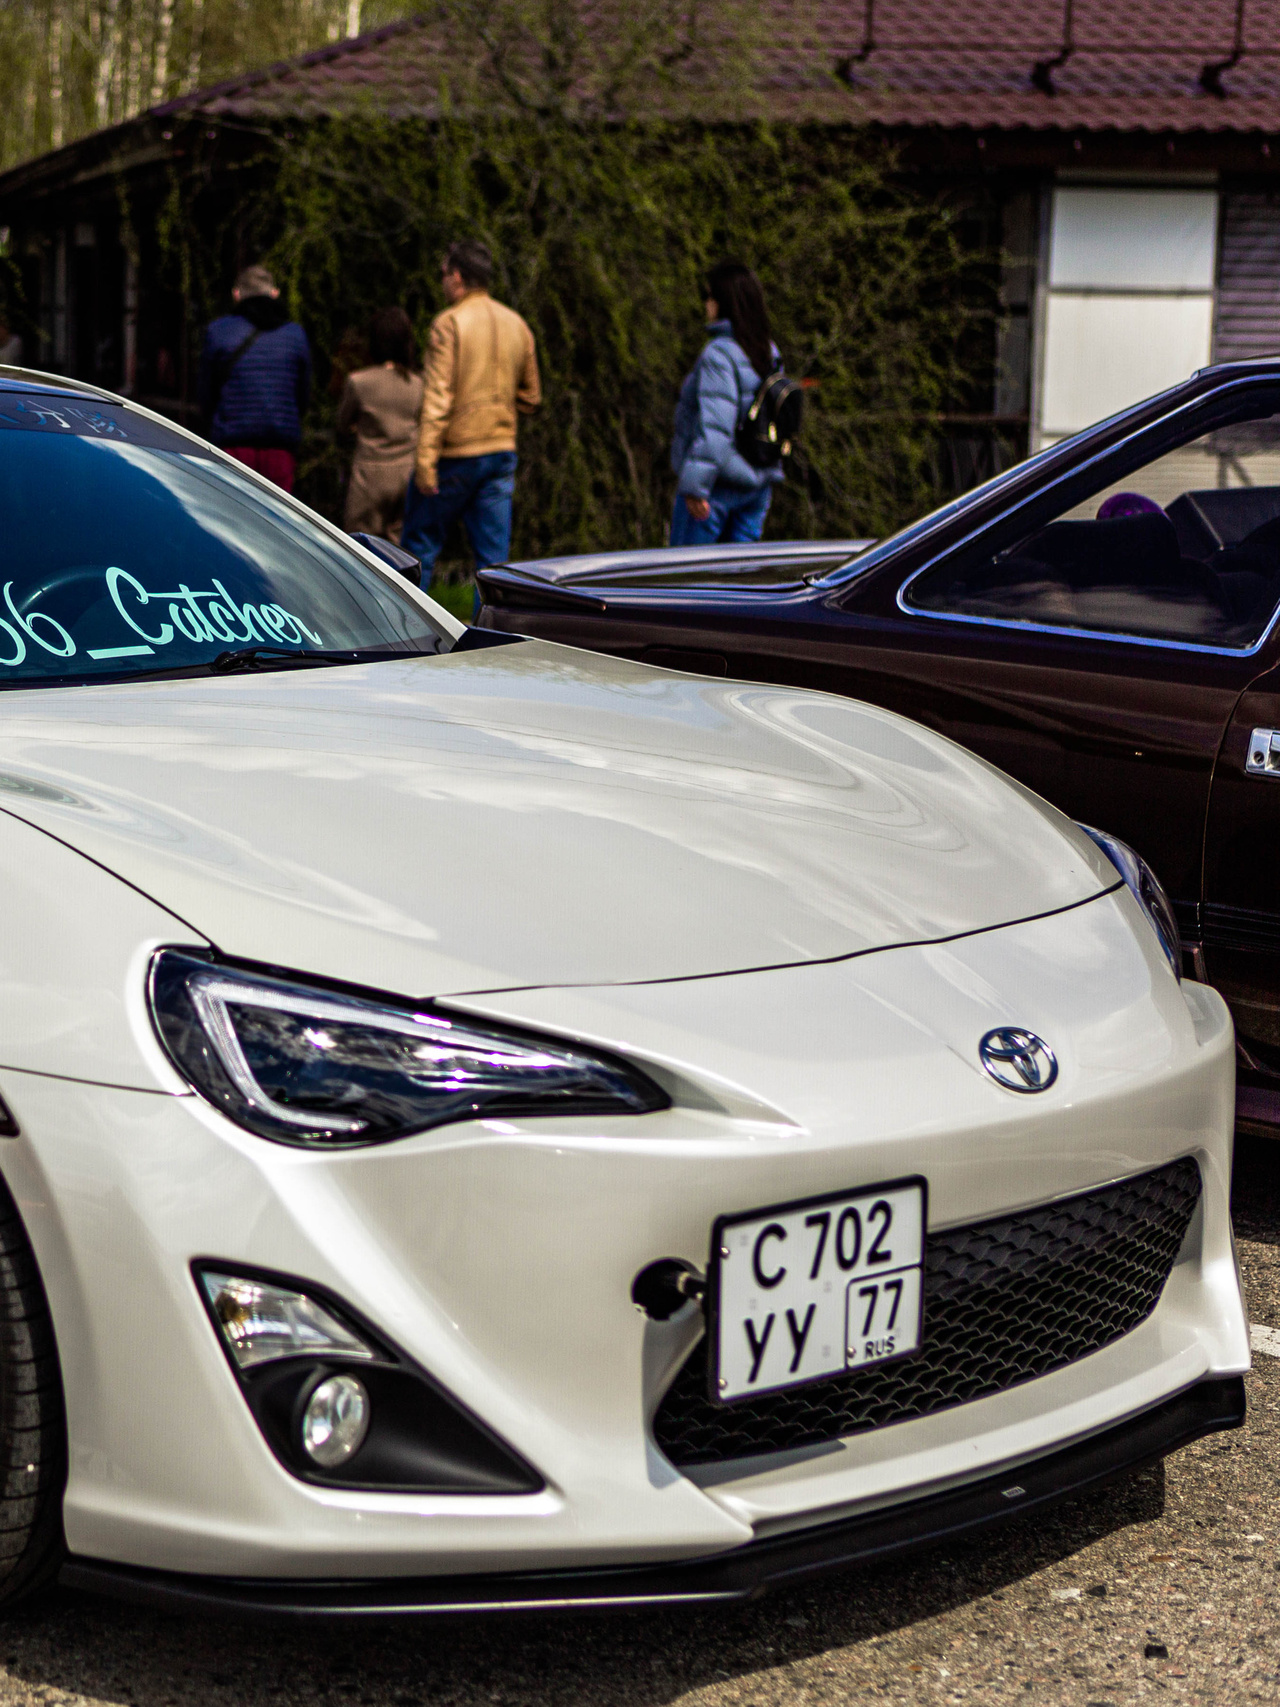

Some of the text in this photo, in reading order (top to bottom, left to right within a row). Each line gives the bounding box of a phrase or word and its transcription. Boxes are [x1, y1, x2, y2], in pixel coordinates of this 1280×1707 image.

[752, 1200, 893, 1290] C 702
[858, 1278, 904, 1337] 77
[864, 1336, 896, 1359] RUS
